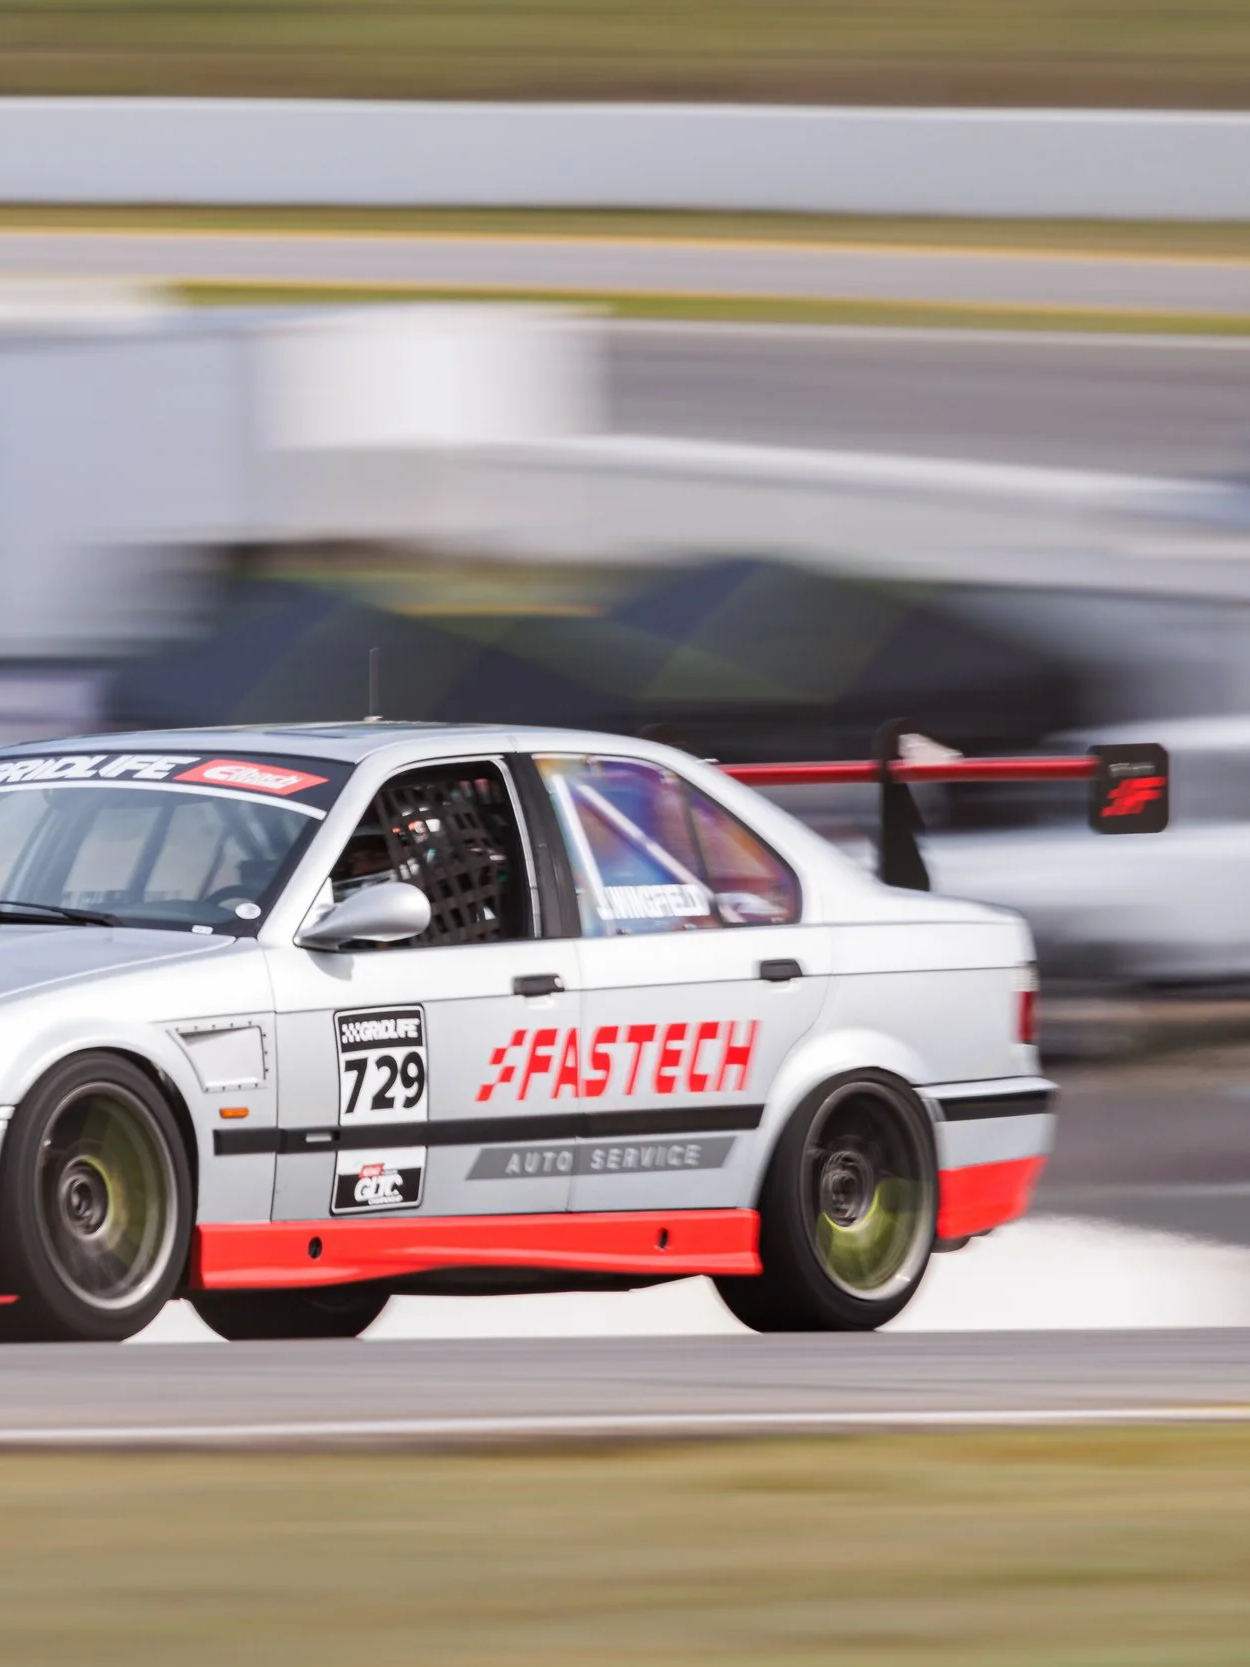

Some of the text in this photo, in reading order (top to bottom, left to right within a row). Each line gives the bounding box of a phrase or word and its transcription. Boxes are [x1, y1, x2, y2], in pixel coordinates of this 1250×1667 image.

[360, 1018, 420, 1042] GRIDLIFE
[344, 1051, 425, 1114] 729
[516, 1019, 762, 1101] FASTECH
[505, 1144, 701, 1174] AUTO SERVICE
